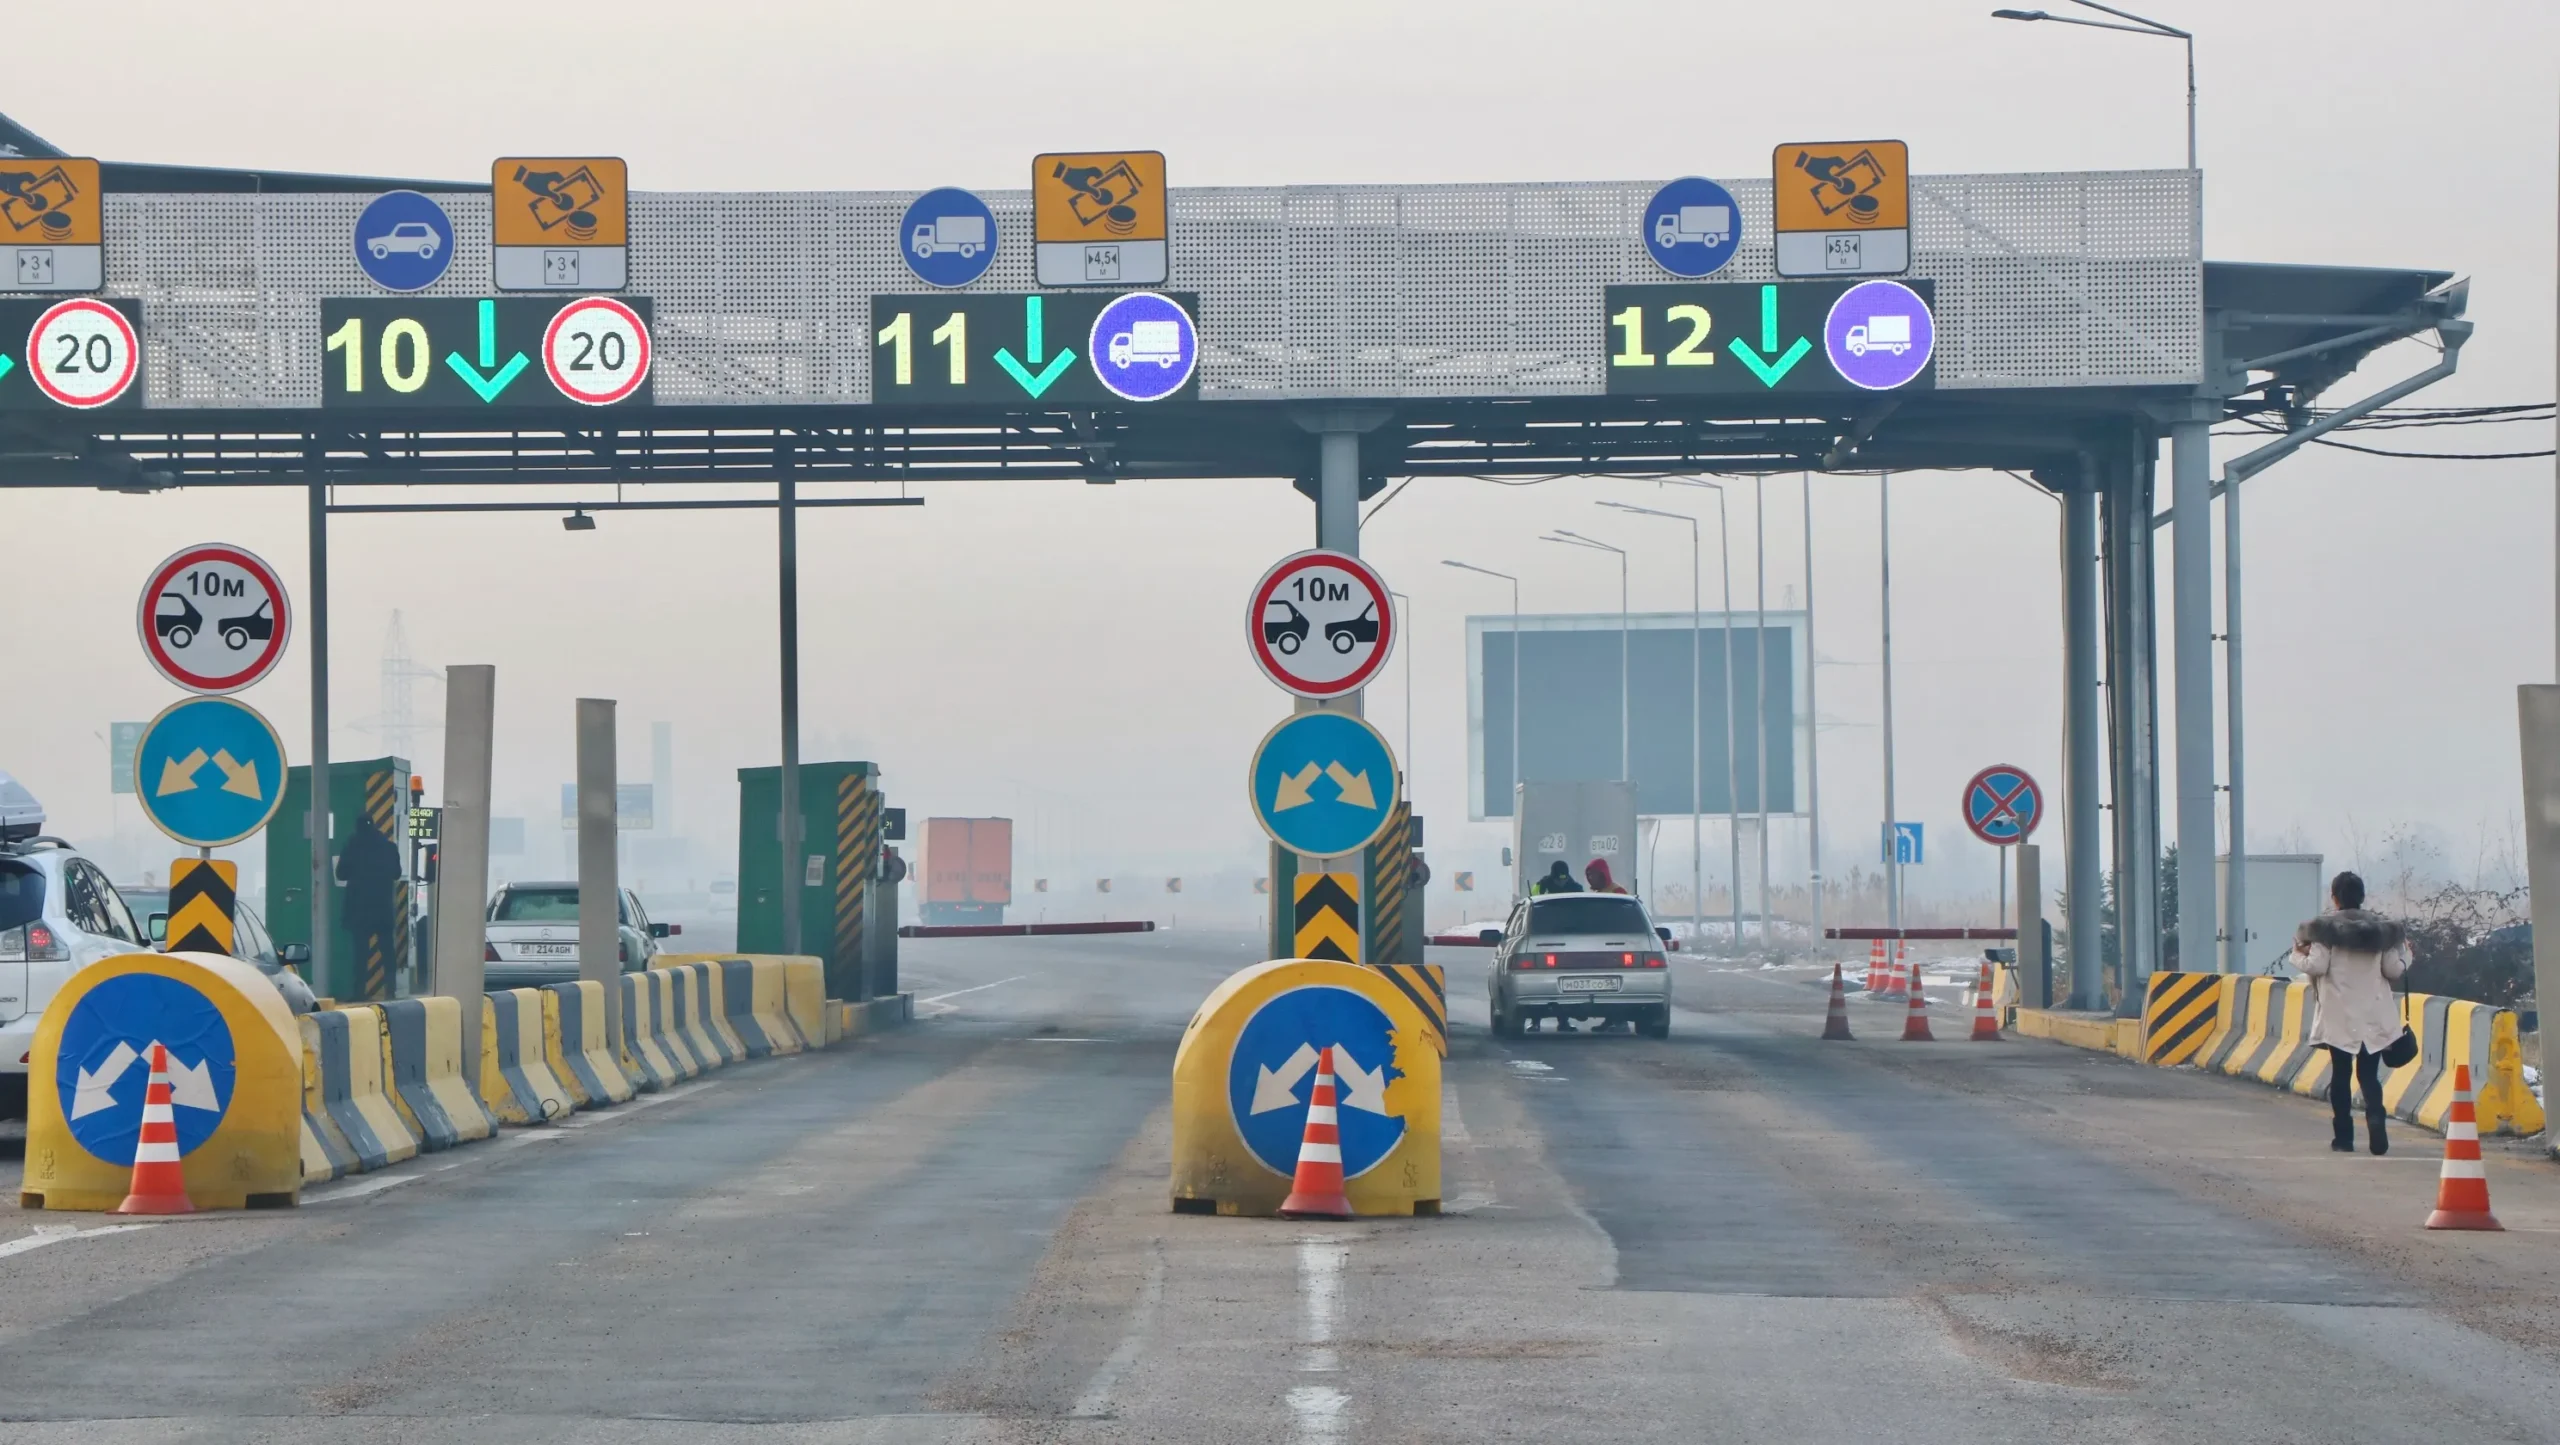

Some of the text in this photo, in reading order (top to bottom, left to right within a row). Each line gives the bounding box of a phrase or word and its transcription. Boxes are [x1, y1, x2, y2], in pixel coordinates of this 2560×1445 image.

[1094, 251, 1111, 267] 4,5
[1835, 239, 1851, 256] 5,5
[31, 255, 41, 271] 3
[557, 256, 567, 272] 3
[878, 312, 966, 385] 11
[1612, 304, 1715, 367] 12
[55, 333, 112, 374] 20
[327, 318, 430, 393] 10
[569, 331, 626, 371] 20
[536, 945, 554, 954] 214
